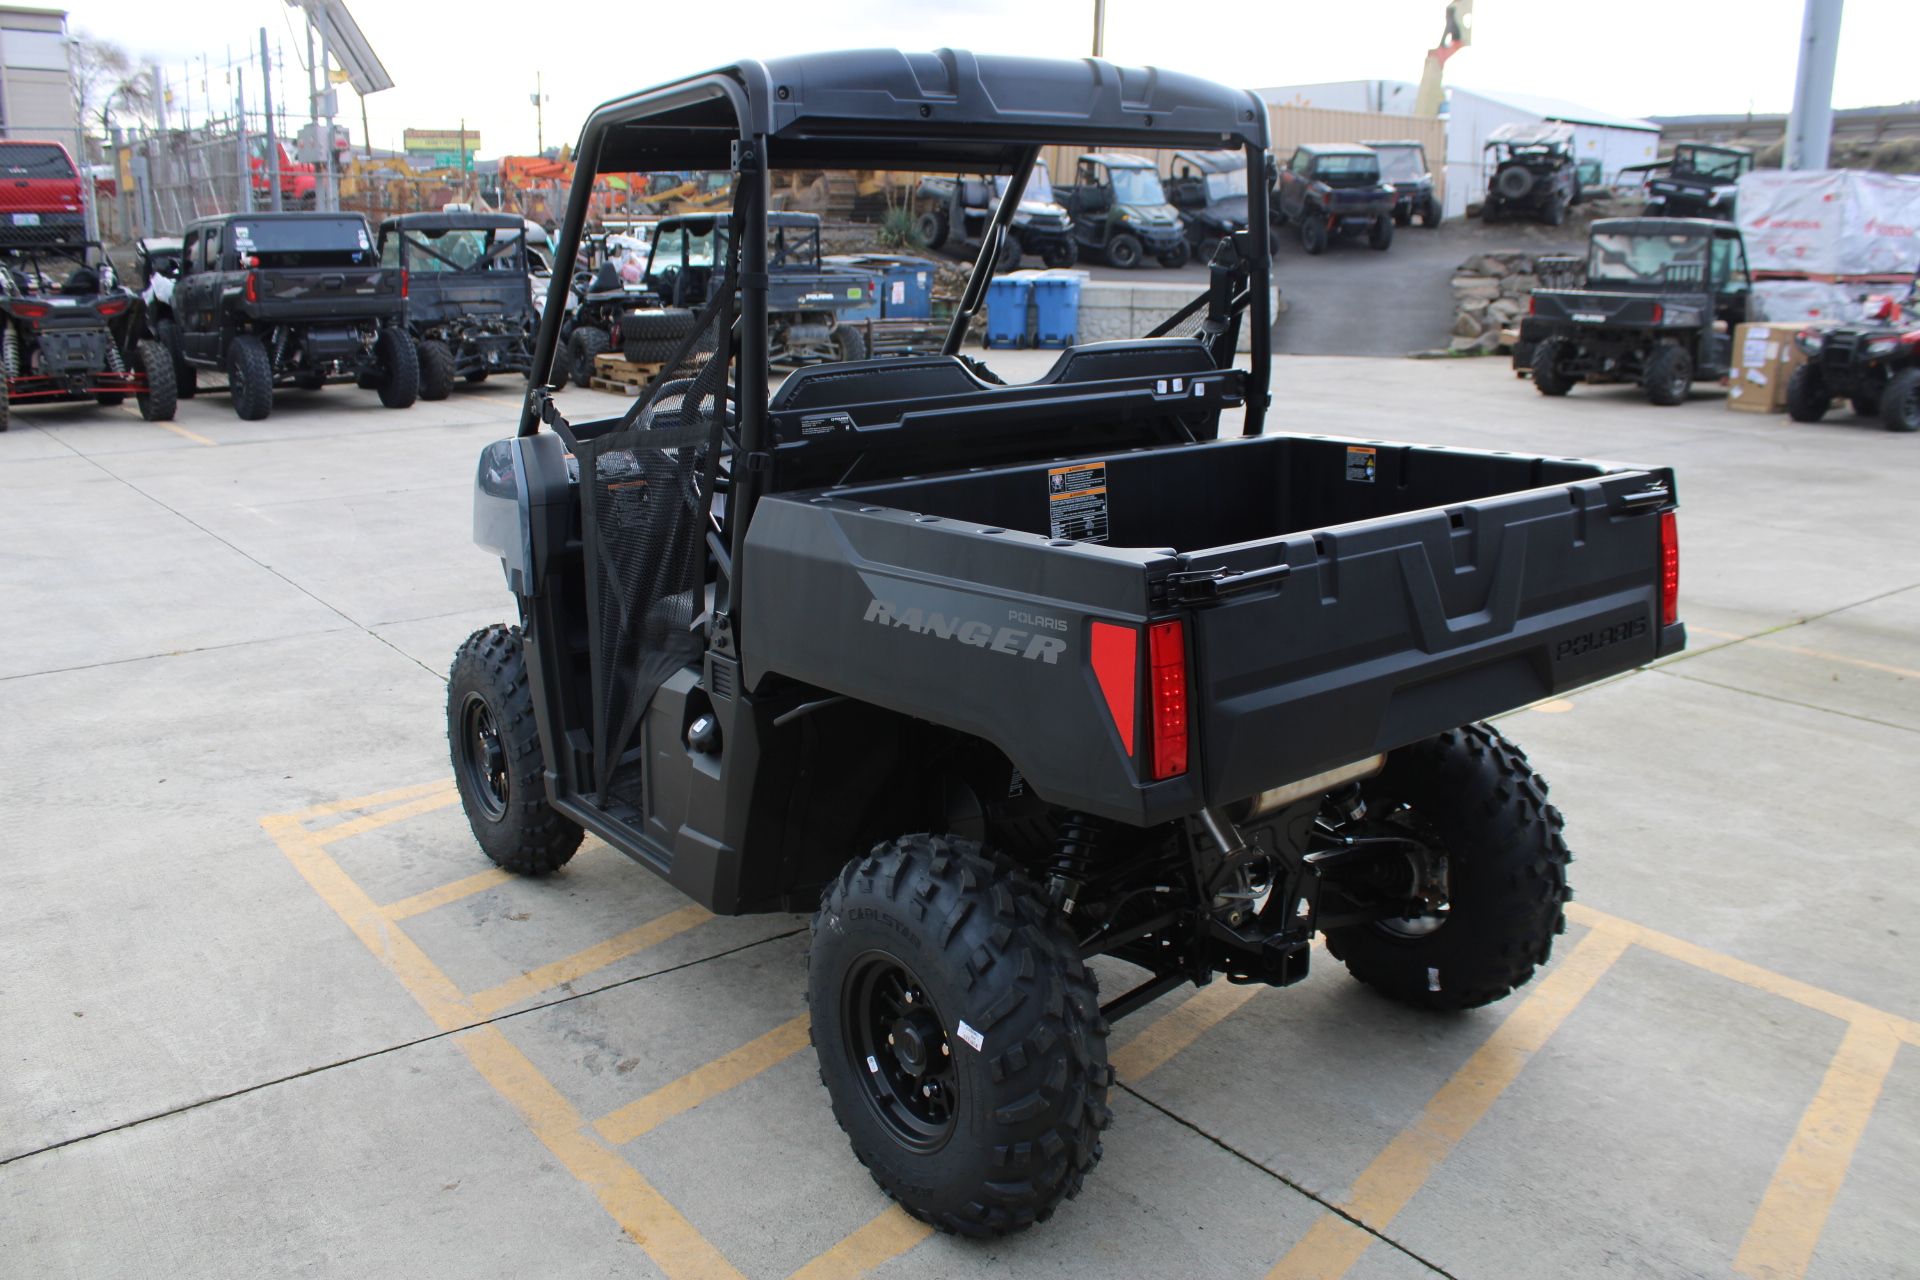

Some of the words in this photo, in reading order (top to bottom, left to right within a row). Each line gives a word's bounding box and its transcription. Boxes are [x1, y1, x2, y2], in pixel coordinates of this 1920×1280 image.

[863, 599, 1067, 665] RANGER
[1008, 609, 1068, 632] POLARIS
[1556, 617, 1647, 662] POLARIS
